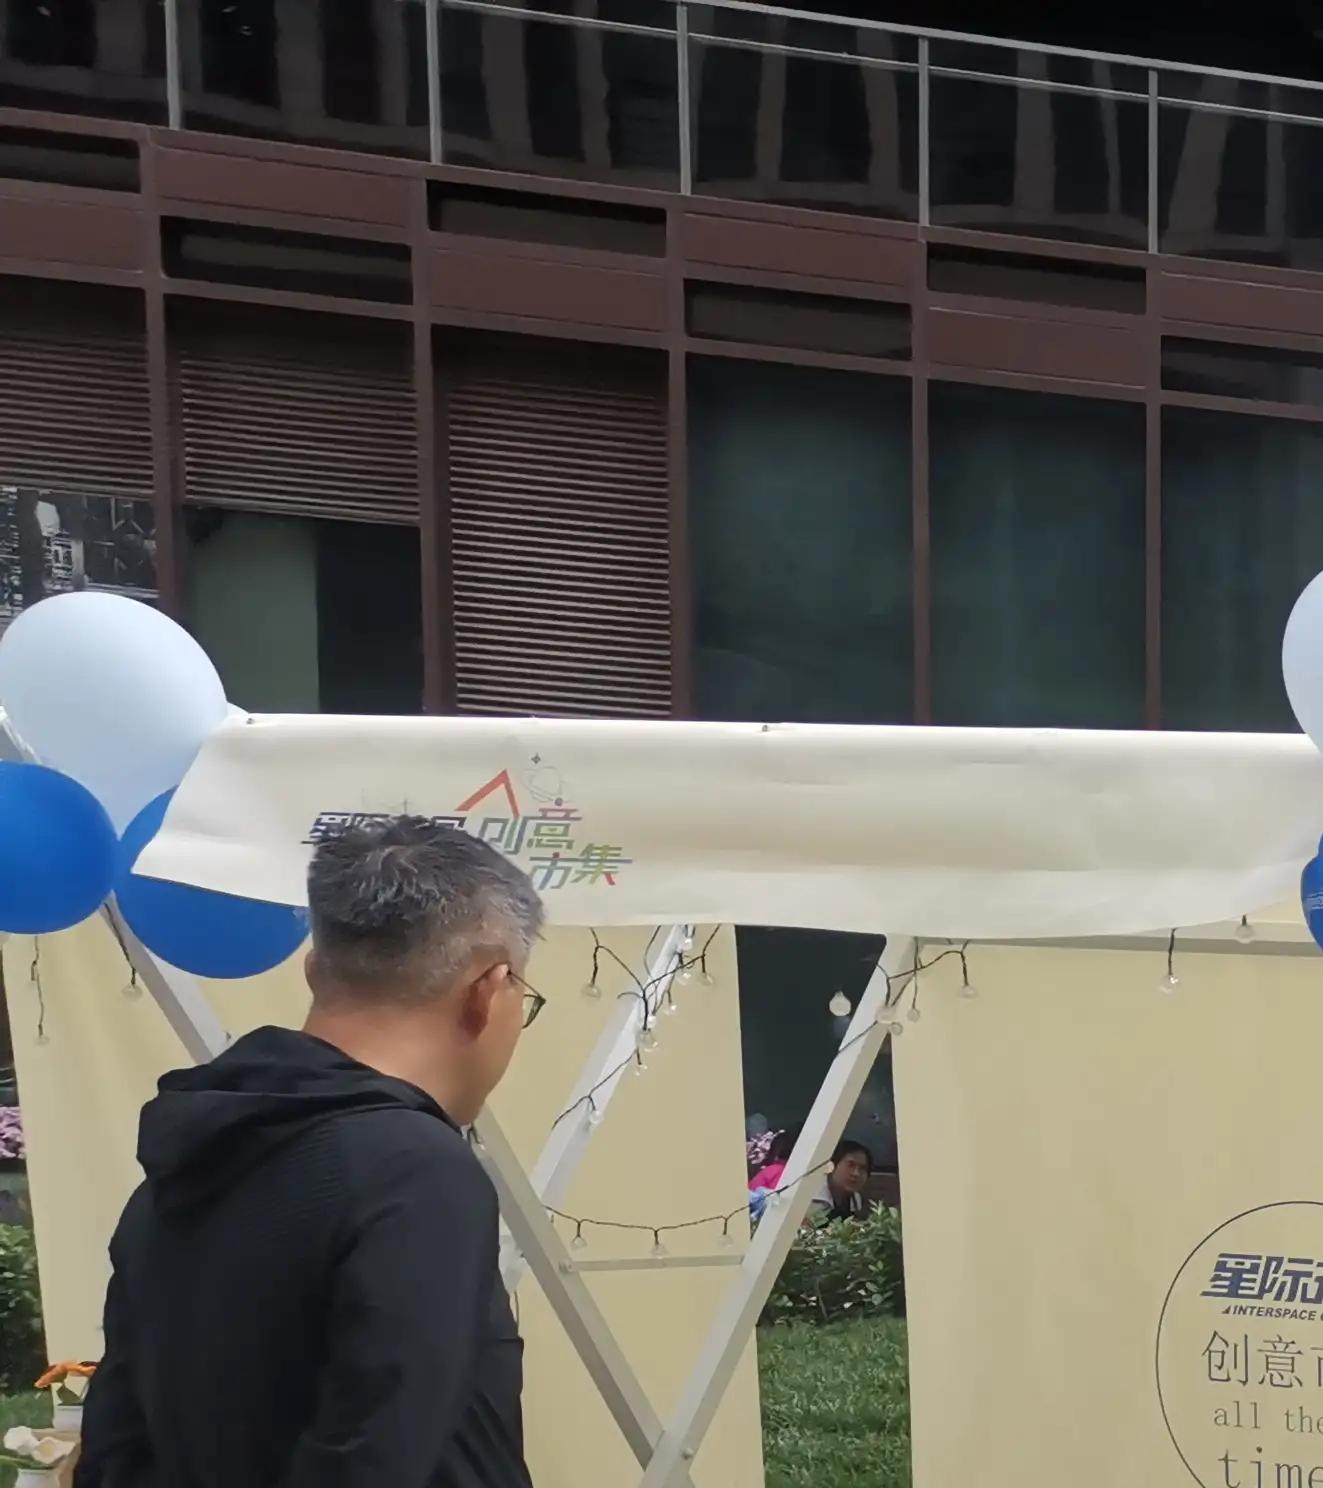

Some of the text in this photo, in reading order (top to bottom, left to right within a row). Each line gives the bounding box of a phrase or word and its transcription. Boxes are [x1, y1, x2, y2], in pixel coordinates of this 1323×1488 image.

[528, 843, 633, 891] 市集
[1232, 1304, 1317, 1322] INTERSPACE
[1213, 1400, 1261, 1430] all
